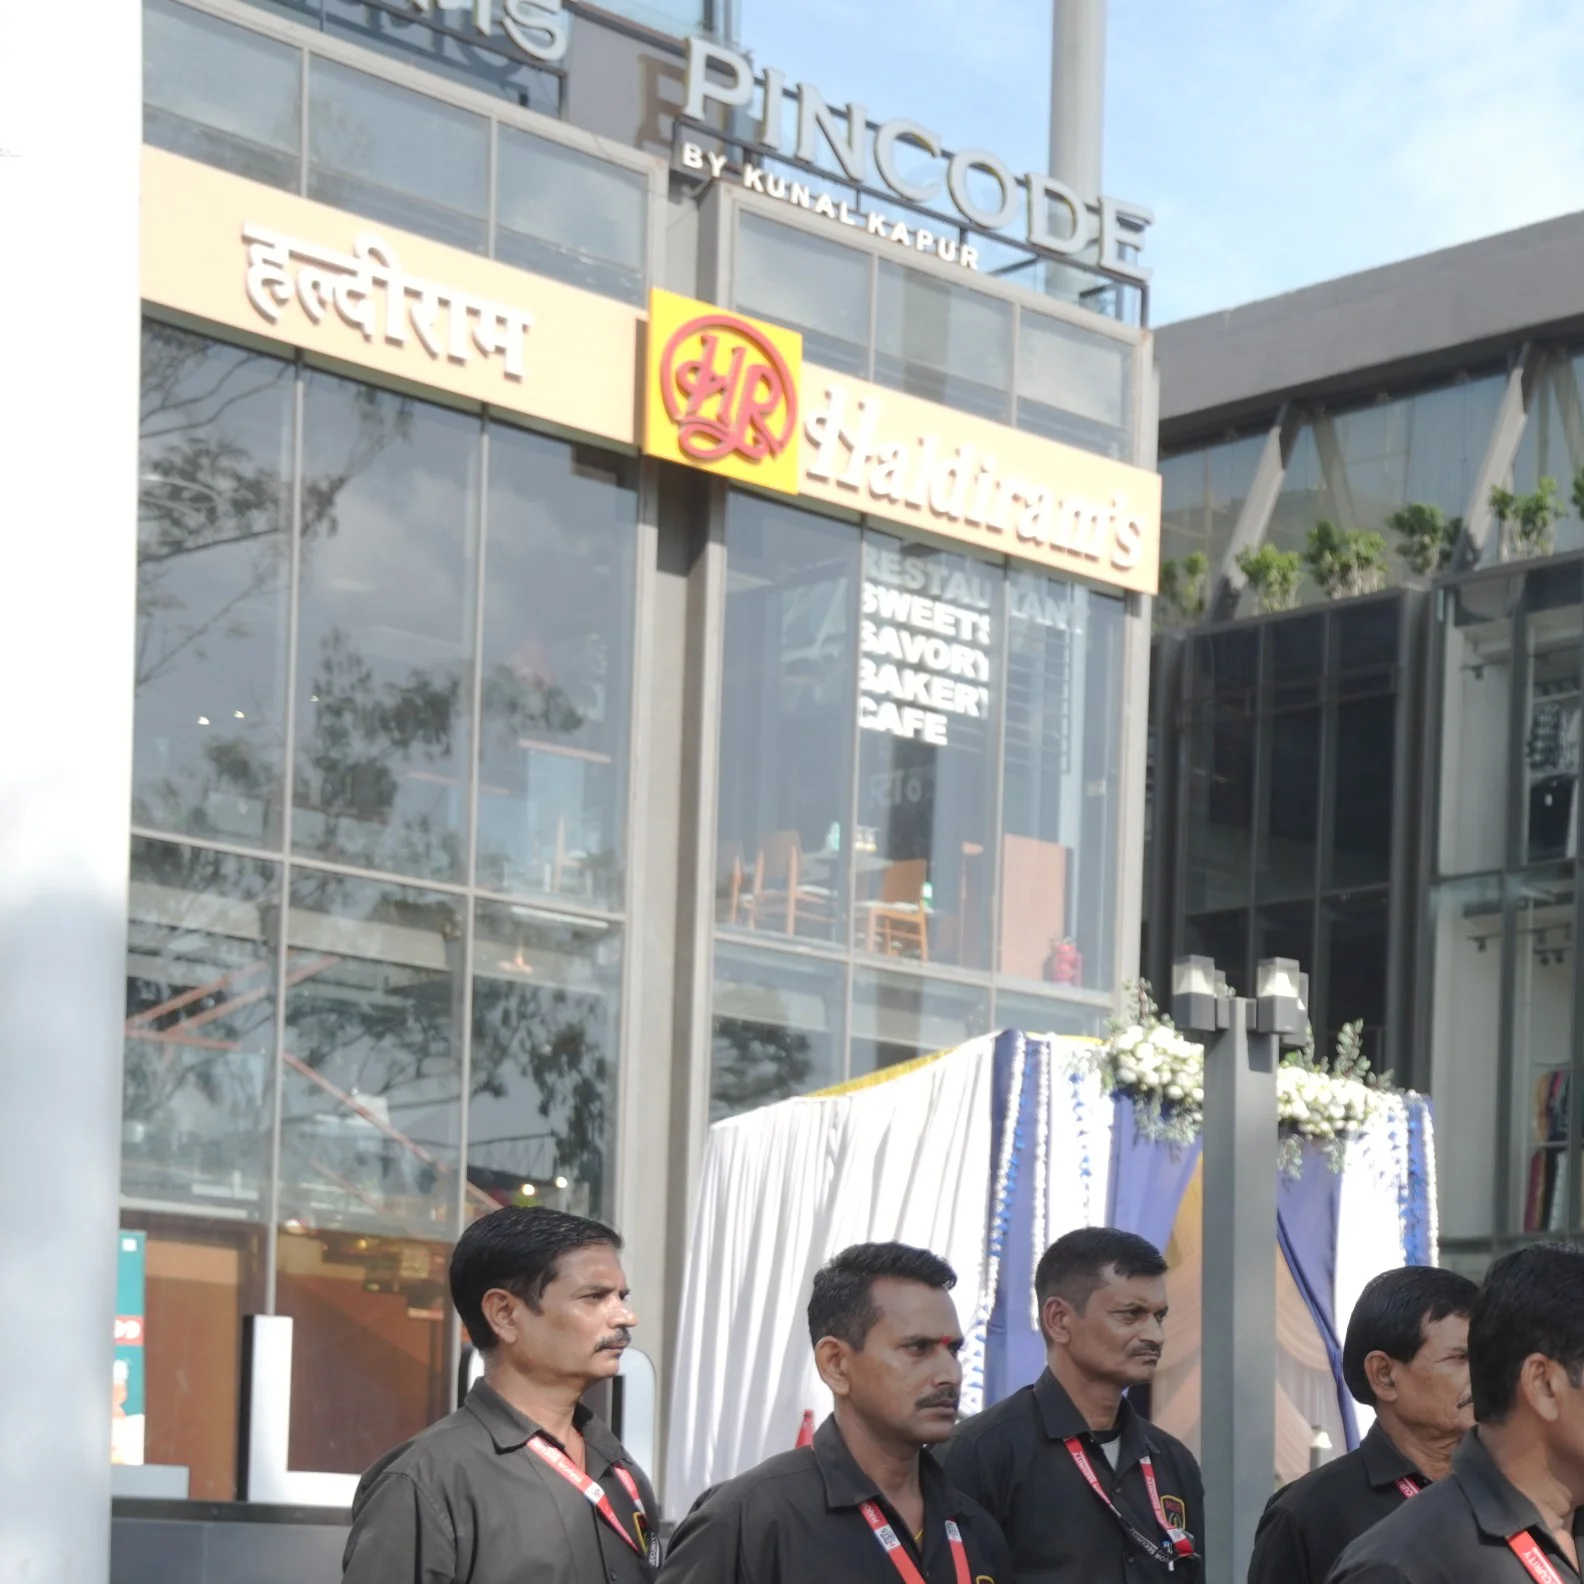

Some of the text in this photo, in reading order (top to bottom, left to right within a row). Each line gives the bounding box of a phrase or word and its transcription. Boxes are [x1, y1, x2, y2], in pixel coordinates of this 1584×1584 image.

[682, 142, 980, 271] BY KUNAL KAPUR
[685, 37, 1155, 283] PINCODE
[240, 220, 535, 384] हल्दीराम
[803, 386, 1147, 570] Haldiram's
[858, 695, 948, 746] CAFE
